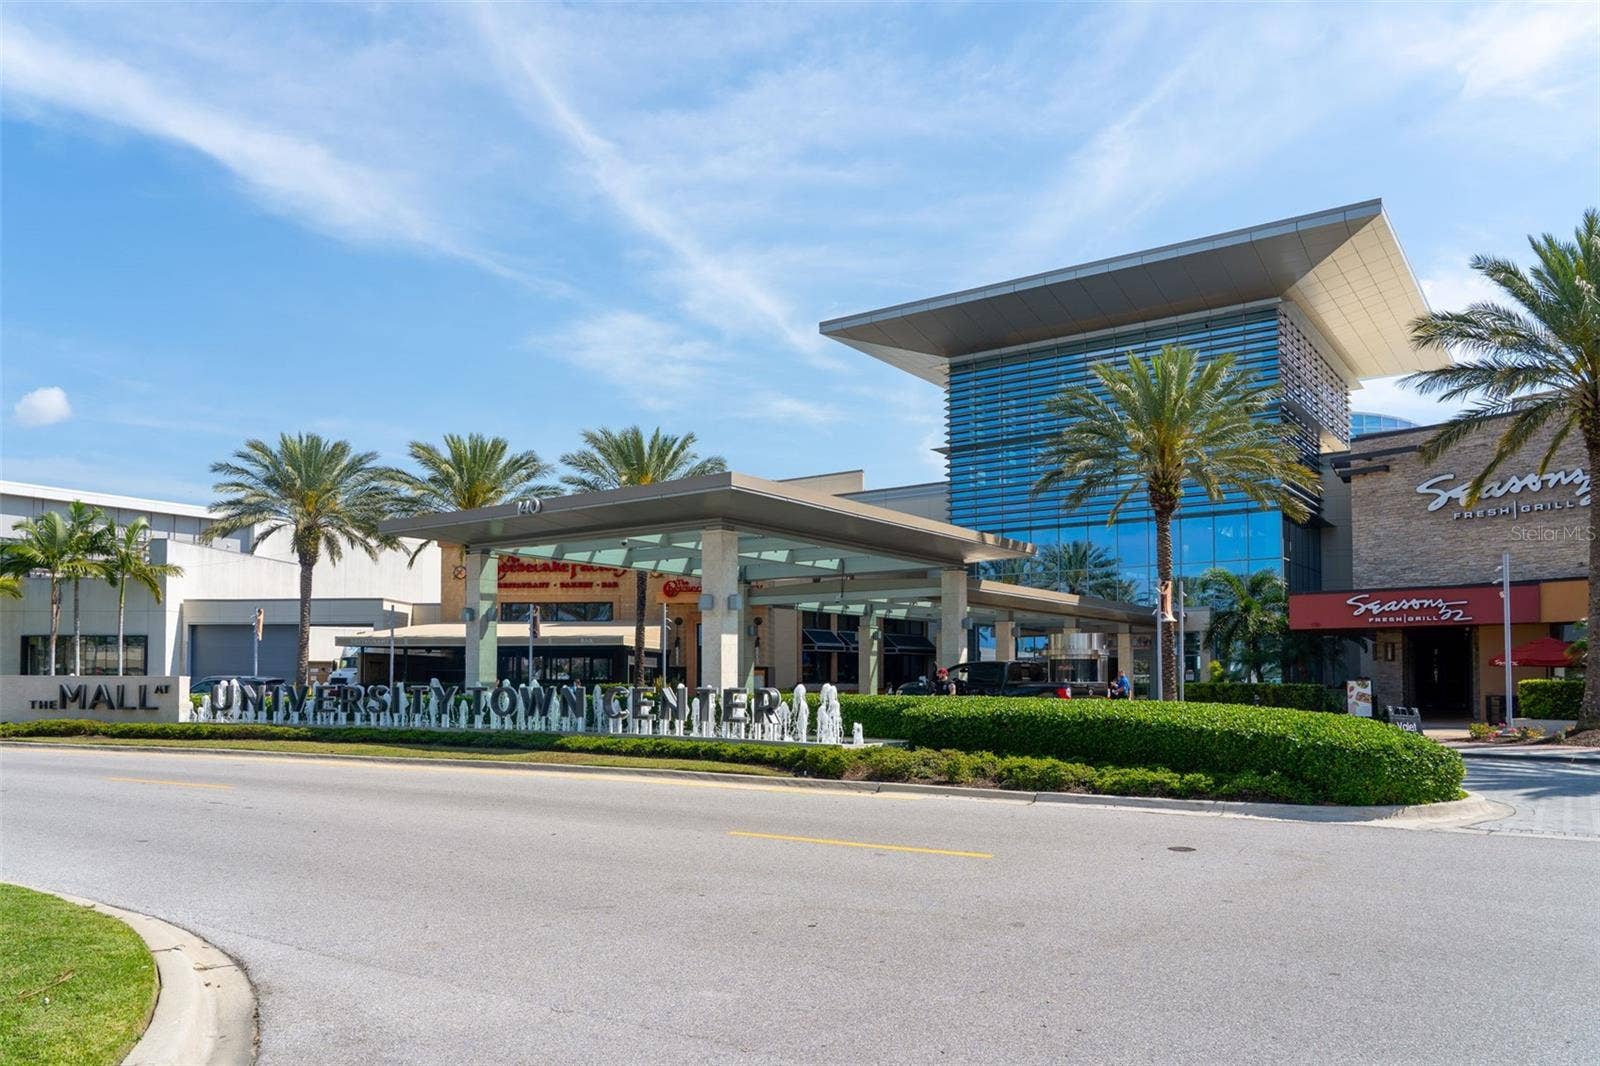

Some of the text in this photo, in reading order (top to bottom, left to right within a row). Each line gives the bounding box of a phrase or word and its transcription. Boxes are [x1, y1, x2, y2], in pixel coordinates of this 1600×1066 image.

[1416, 468, 1591, 512] Seasons
[1453, 501, 1574, 520] FRESH GRILL
[1346, 594, 1473, 621] Seasons 52
[29, 684, 171, 710] THE MALL AT
[211, 684, 782, 725] UNIVERSITY TOWN CENTER
[1396, 721, 1417, 732] Valet
